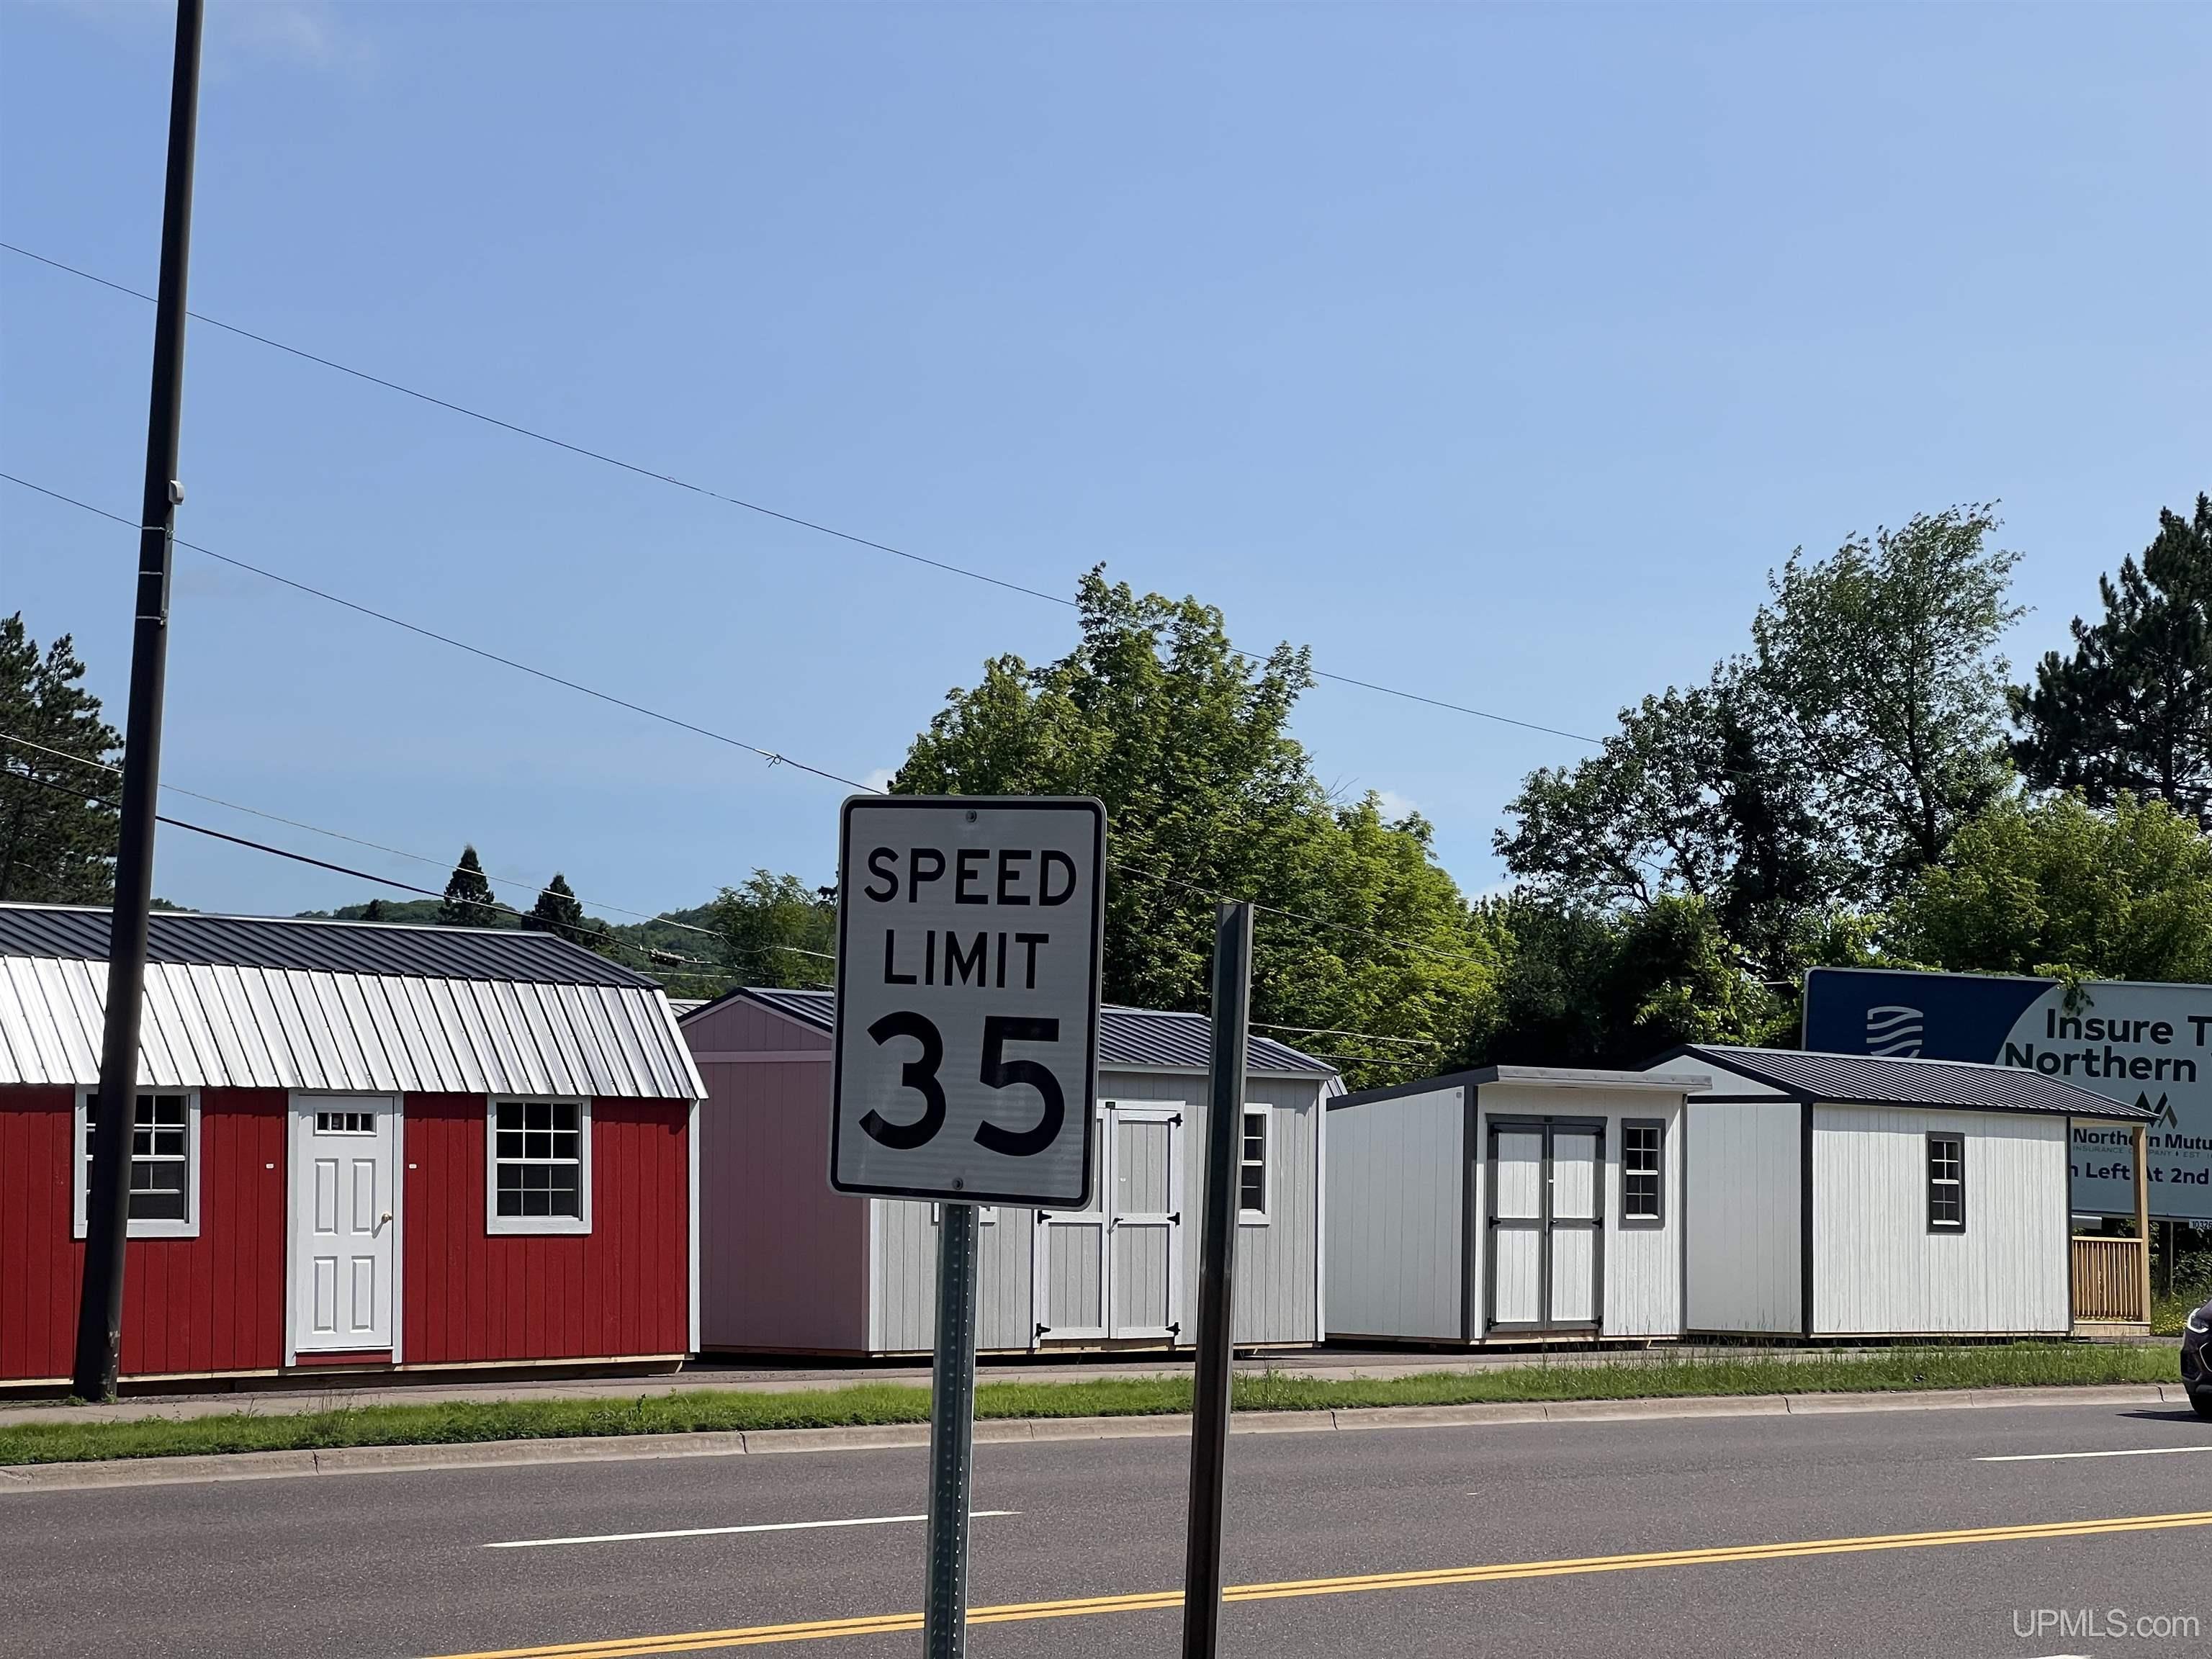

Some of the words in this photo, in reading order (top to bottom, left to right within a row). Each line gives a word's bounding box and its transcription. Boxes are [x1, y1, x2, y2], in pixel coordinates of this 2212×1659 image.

[864, 847, 1076, 907] SPEED
[884, 929, 1049, 989] LIMIT
[2046, 1008, 2174, 1045] Insure
[2005, 1042, 2196, 1082] Northern
[858, 1011, 1065, 1156] 35
[2073, 1128, 2160, 1148] Northn
[2086, 1162, 2131, 1180] Left
[2171, 1168, 2209, 1184] 2nd
